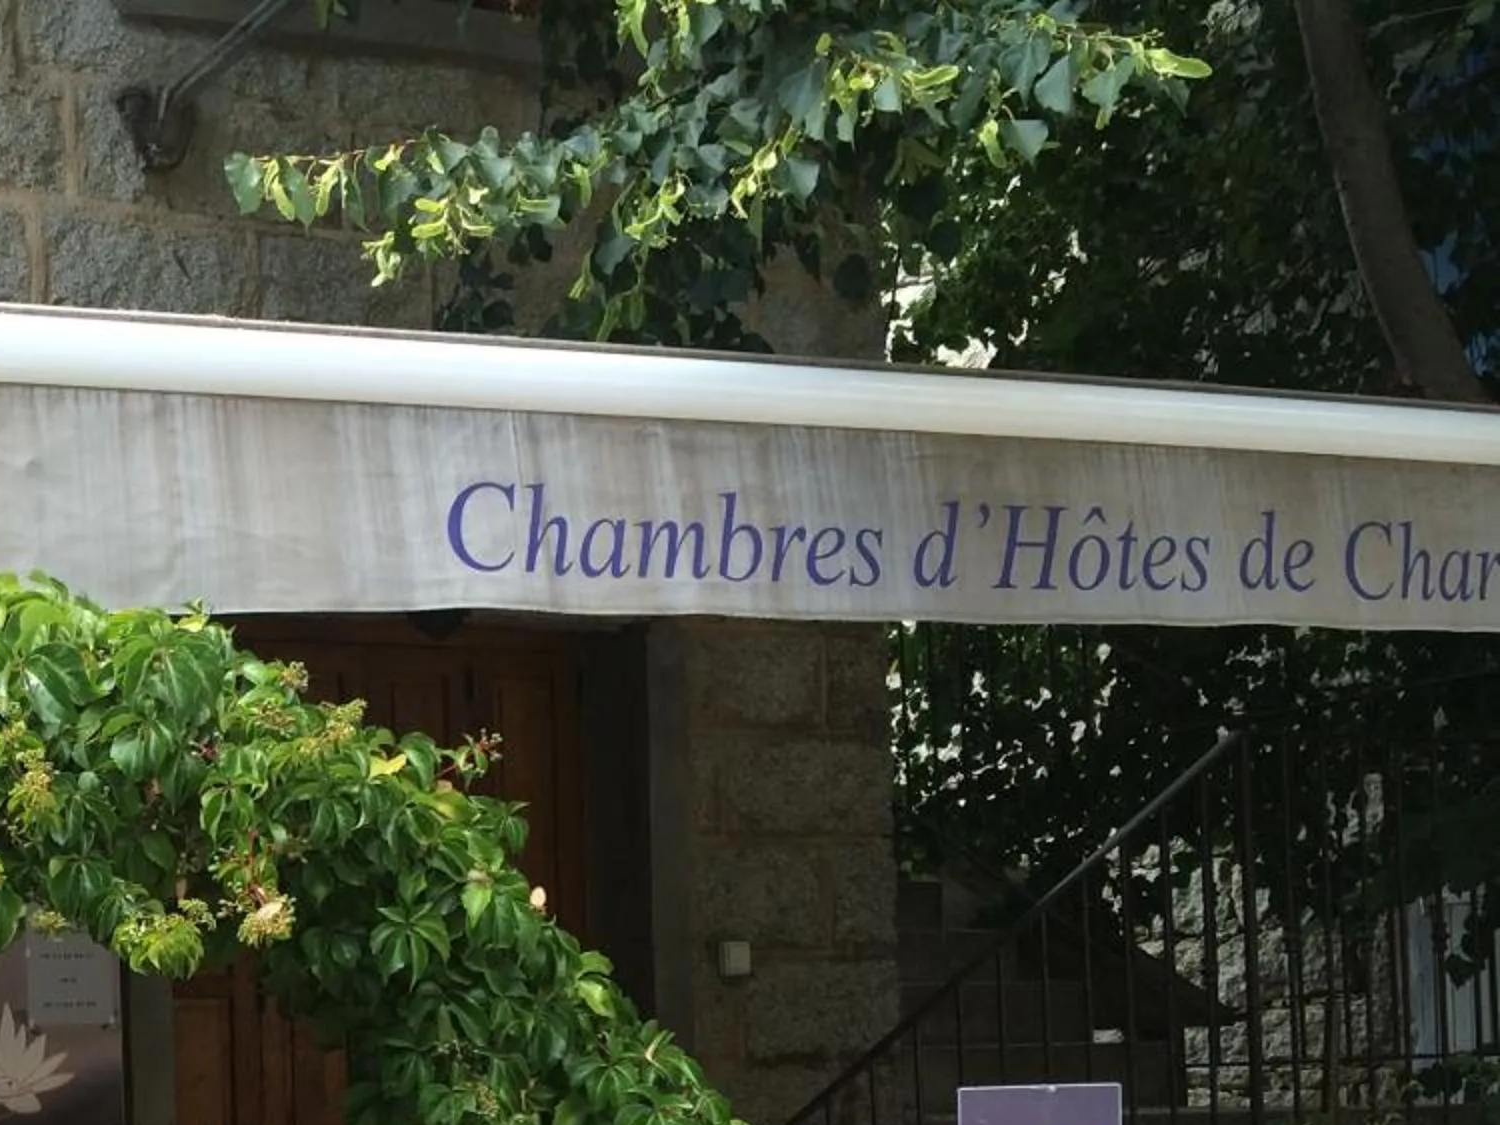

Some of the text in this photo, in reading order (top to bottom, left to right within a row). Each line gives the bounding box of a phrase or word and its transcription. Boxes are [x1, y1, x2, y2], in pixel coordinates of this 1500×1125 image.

[445, 481, 884, 588] Chambres
[913, 500, 1211, 594] d'Hôtes
[1237, 511, 1315, 592] de
